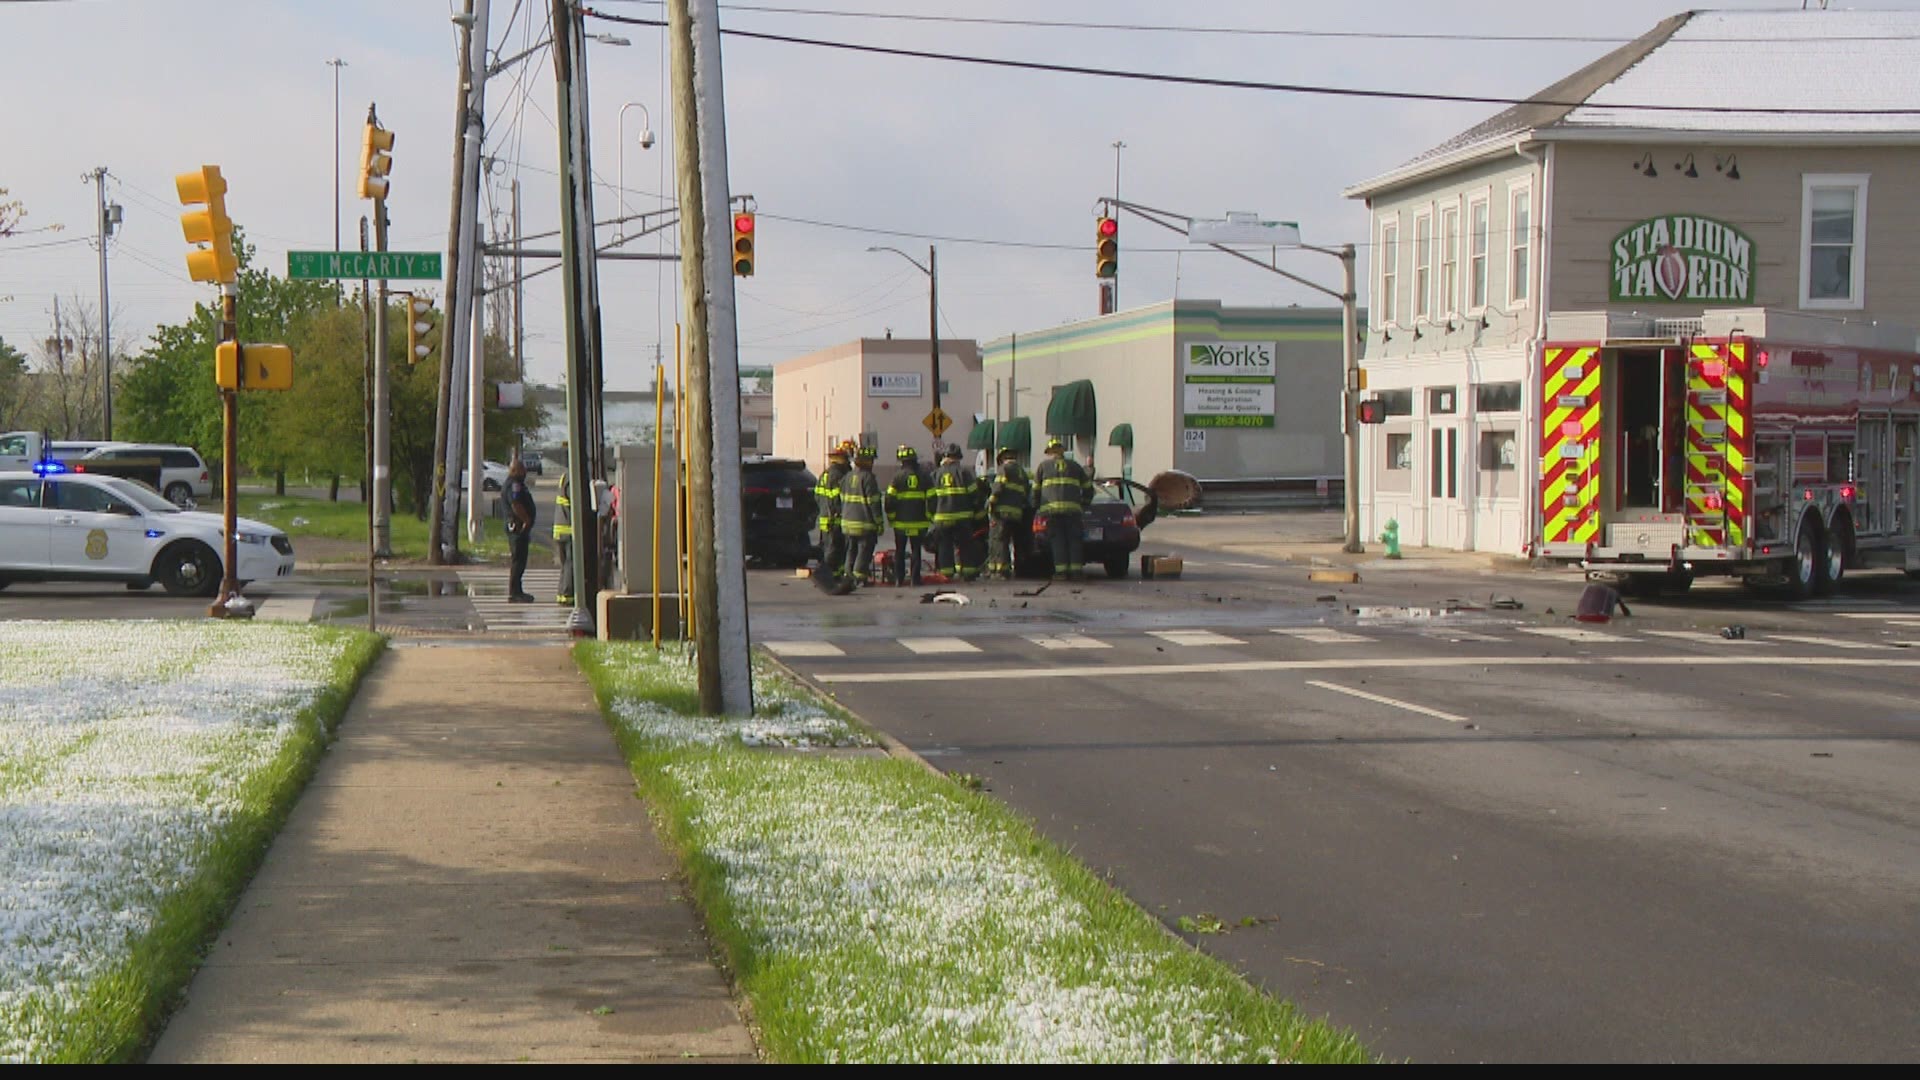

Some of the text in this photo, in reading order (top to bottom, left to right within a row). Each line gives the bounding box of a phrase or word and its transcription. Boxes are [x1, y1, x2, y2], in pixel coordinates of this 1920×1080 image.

[1614, 216, 1751, 273] STADIUM
[329, 255, 436, 276] McCARTY ST
[1614, 252, 1750, 301] TAVERN
[1208, 345, 1270, 367] York's
